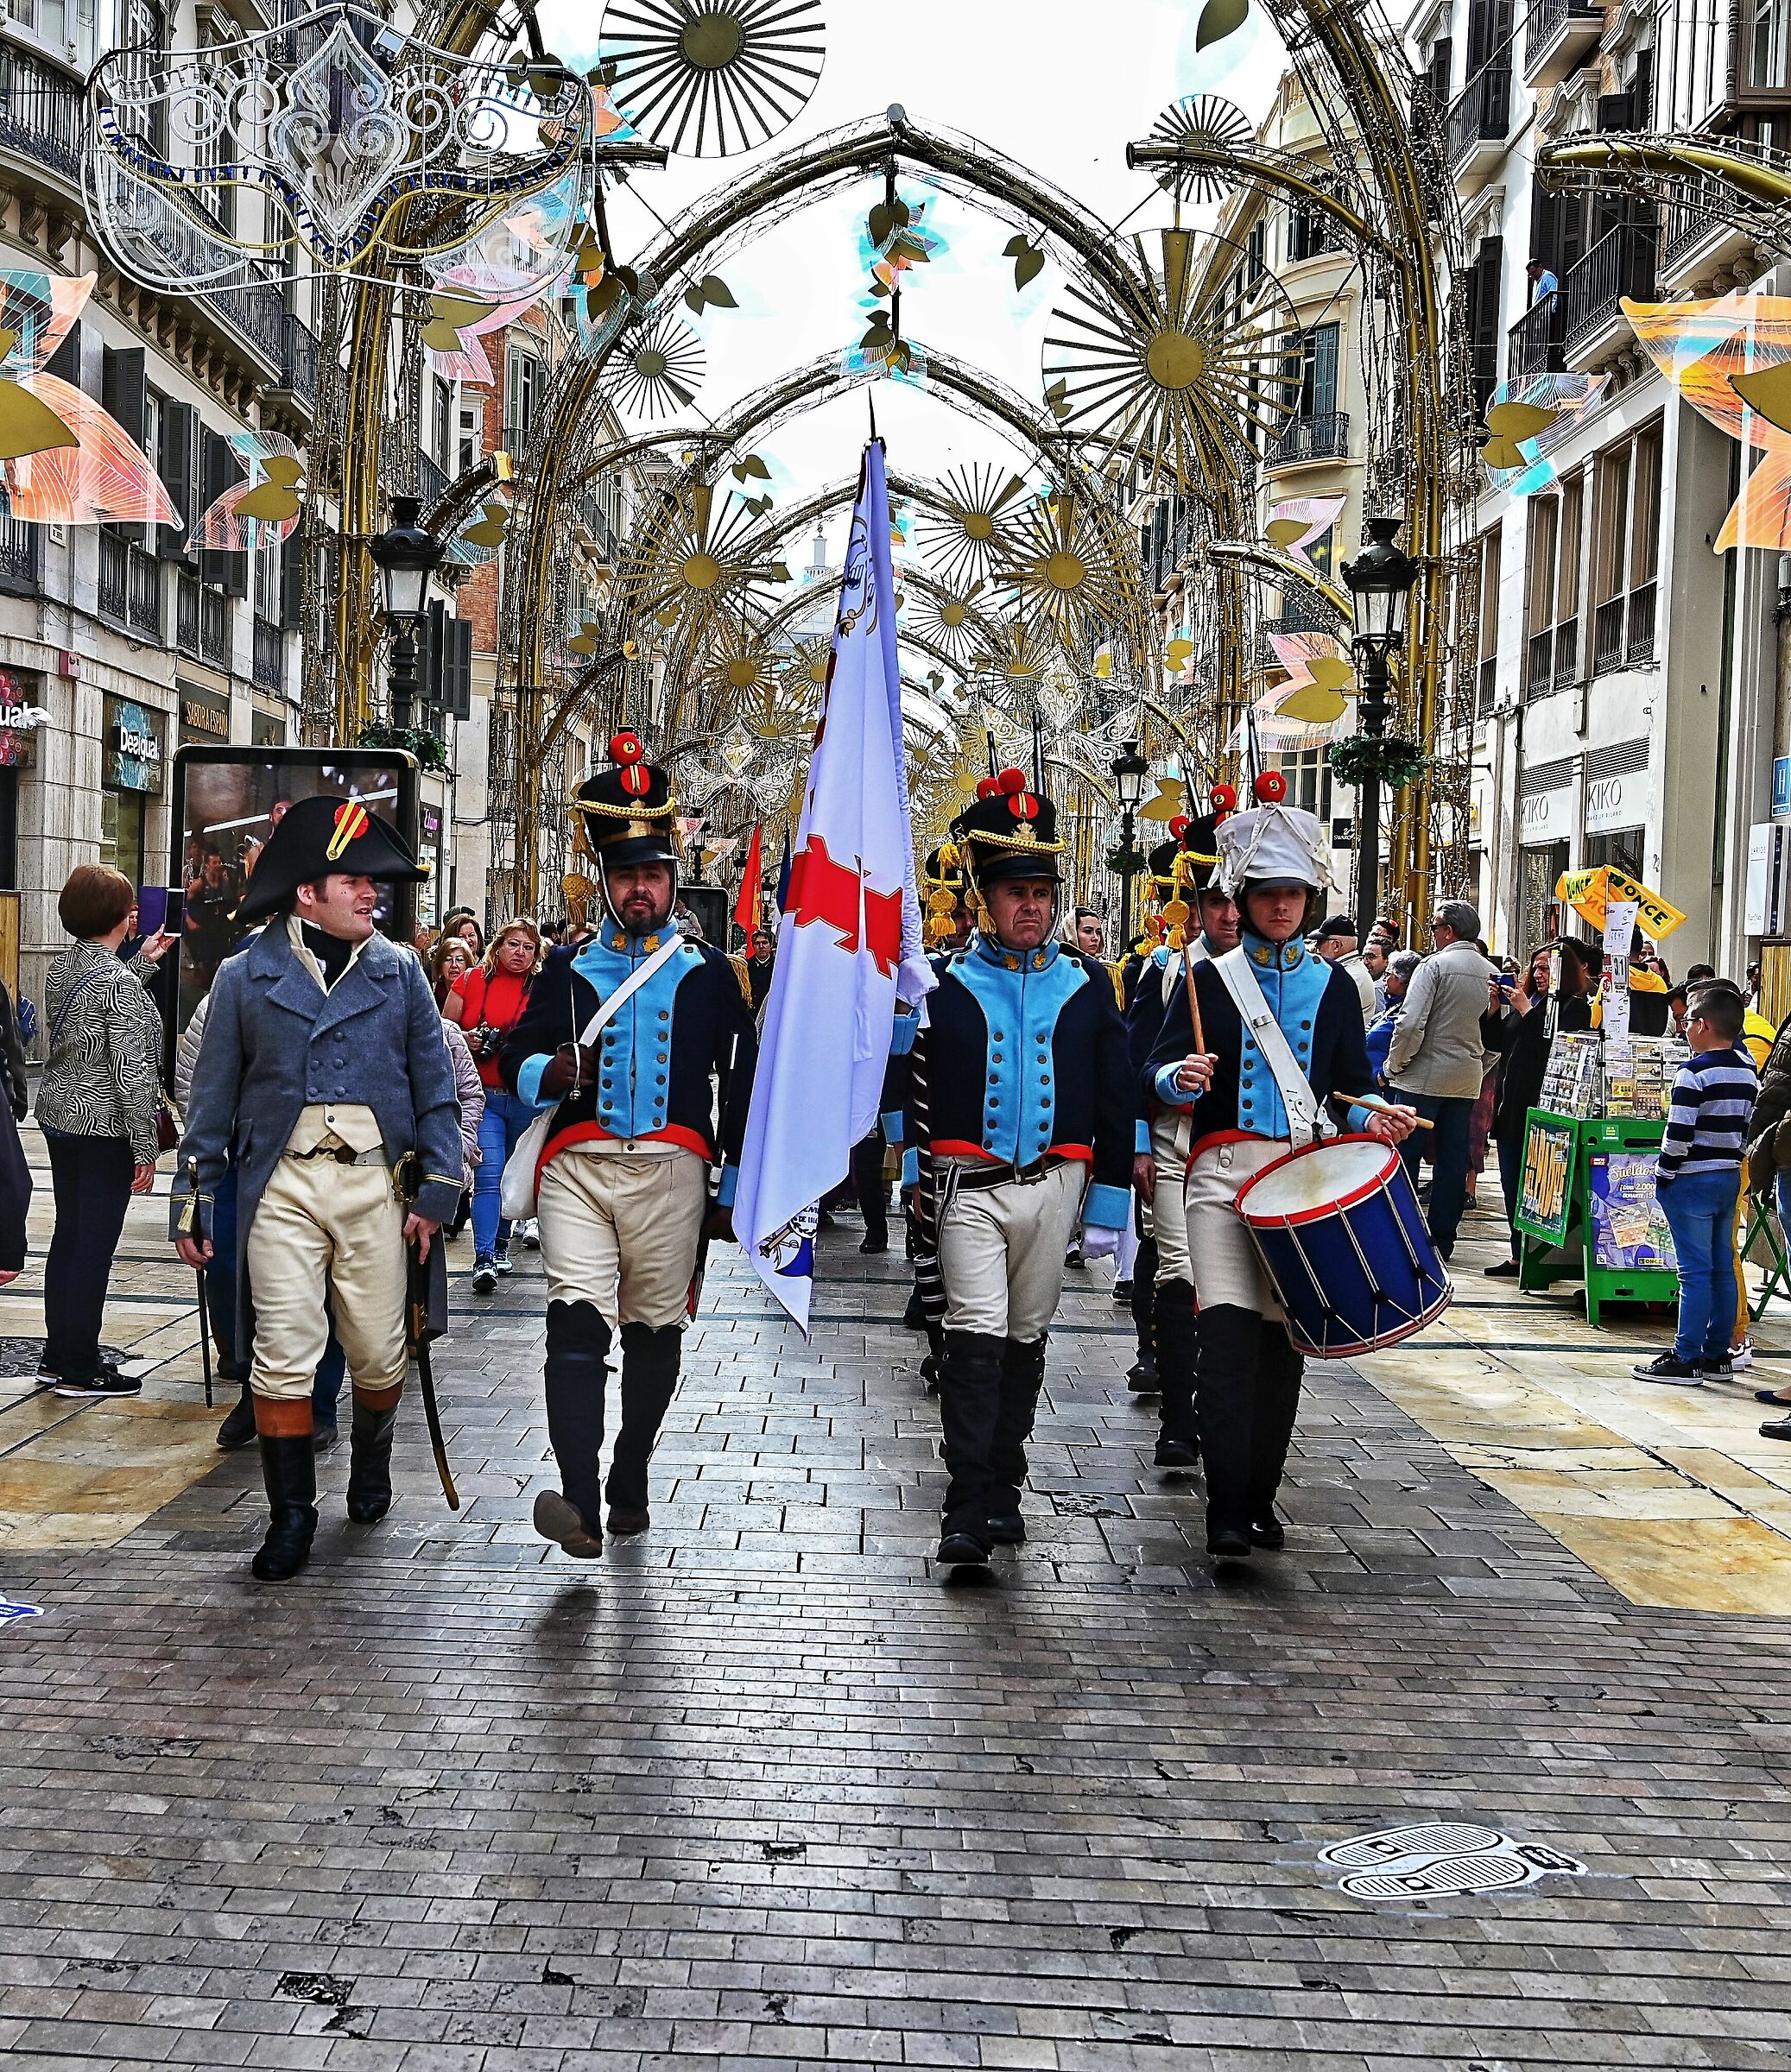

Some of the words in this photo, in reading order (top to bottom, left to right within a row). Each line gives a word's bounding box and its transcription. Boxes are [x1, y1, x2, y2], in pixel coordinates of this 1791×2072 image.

[627, 742, 634, 751] 2
[1271, 780, 1278, 790] 2
[1777, 768, 1787, 795] H
[1587, 779, 1623, 812] KIKO
[1520, 795, 1549, 825] KIKO
[1180, 824, 1186, 833] 2
[1623, 884, 1668, 926] ONCE
[1611, 1163, 1650, 1182] Sueldo
